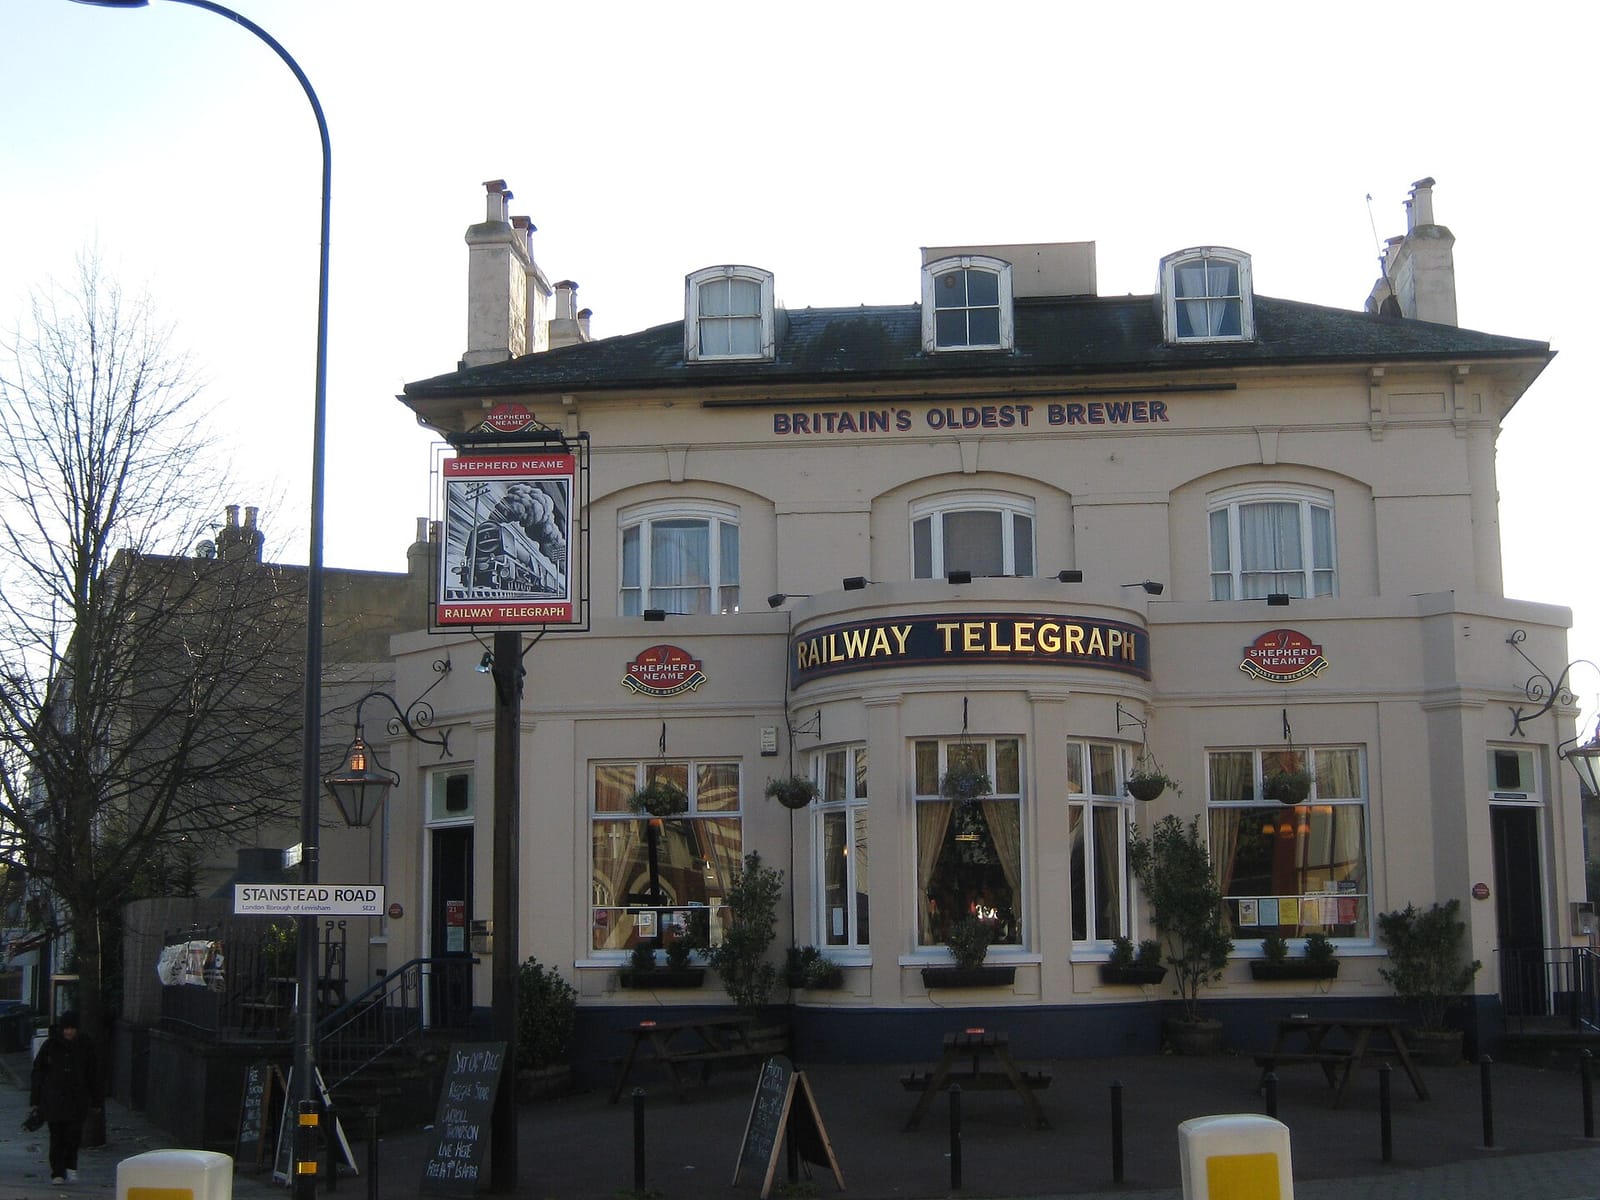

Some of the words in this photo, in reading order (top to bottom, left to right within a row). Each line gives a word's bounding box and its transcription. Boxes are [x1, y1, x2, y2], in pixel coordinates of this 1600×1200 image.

[773, 407, 913, 435] BRITAIN'S
[926, 404, 1033, 431] OLDEST
[1047, 400, 1169, 426] BREWER
[452, 460, 518, 470] SHEPHERD
[522, 460, 564, 469] NEAME
[444, 608, 494, 618] RAILWAY
[498, 607, 565, 617] TELEGRAPH
[798, 624, 913, 670] RAILWAY
[936, 621, 1136, 661] TELEGRAPH
[1250, 648, 1318, 657] SHEPHERD
[1262, 657, 1306, 665] NEAME
[631, 664, 696, 672] SHEPHERD
[643, 672, 685, 680] NEAME
[242, 888, 329, 901] STANSTEAD
[334, 888, 377, 902] ROAD
[266, 904, 291, 912] Borough
